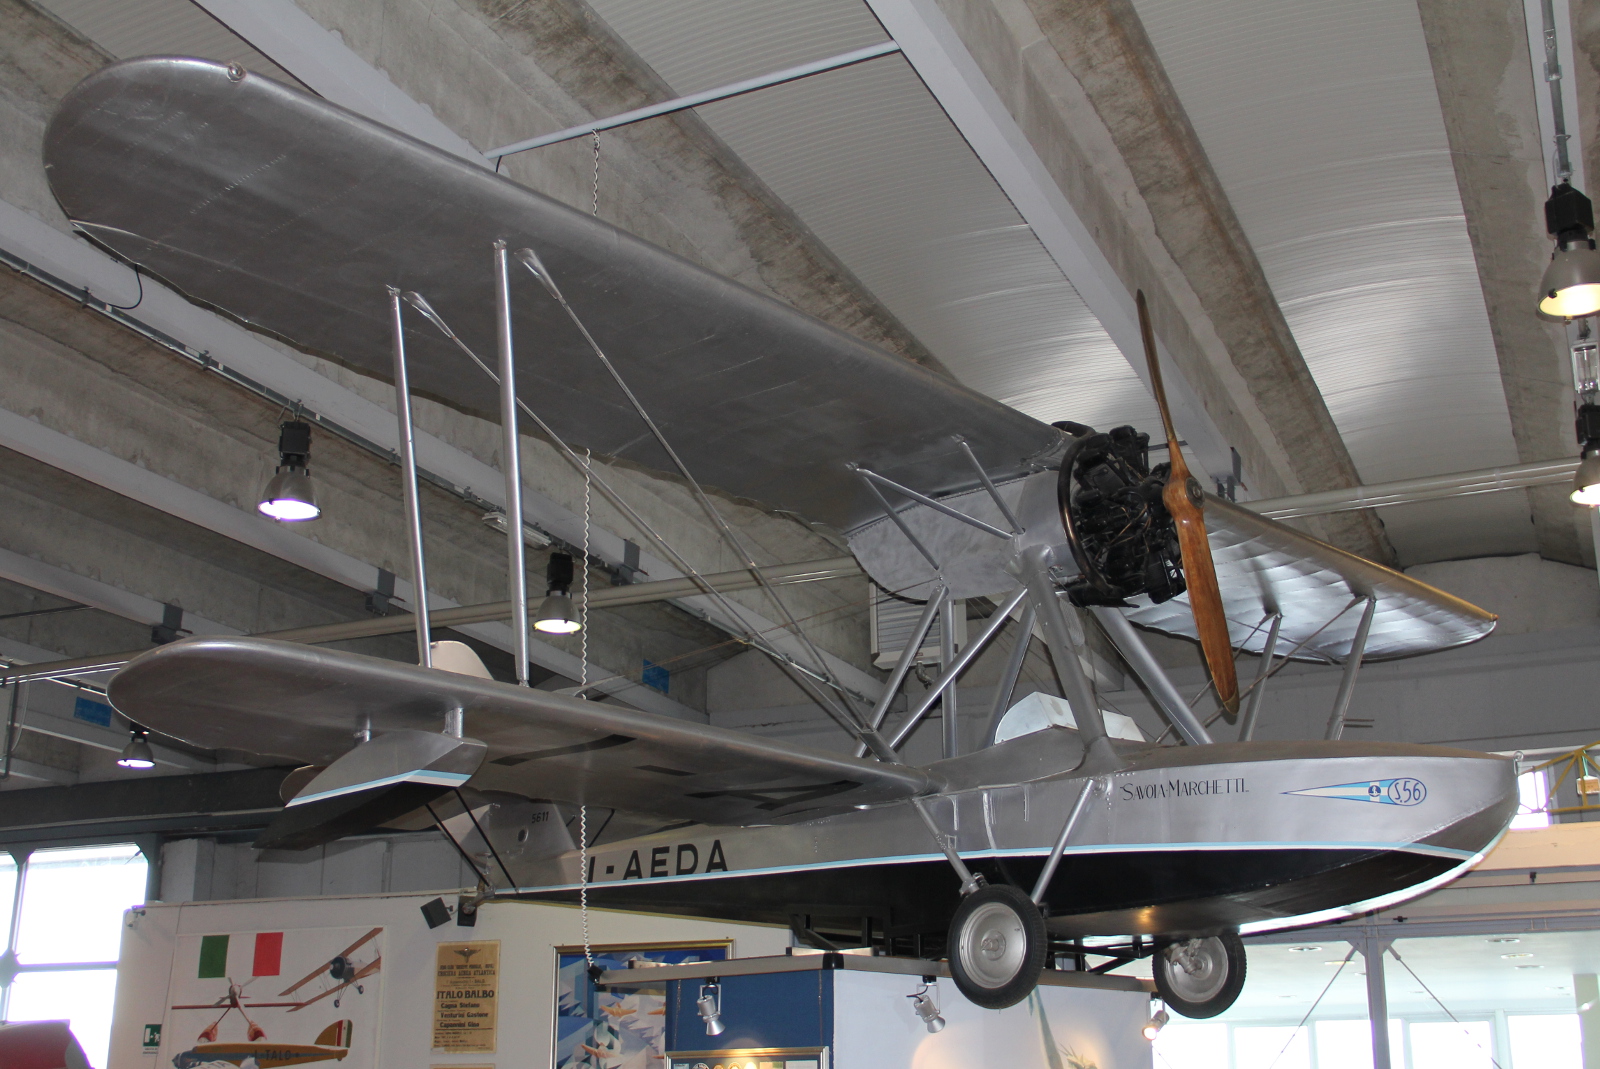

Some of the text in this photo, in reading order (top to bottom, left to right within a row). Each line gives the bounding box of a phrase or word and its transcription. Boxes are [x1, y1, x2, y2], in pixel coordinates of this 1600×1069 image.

[531, 811, 549, 824] 5611
[587, 839, 729, 883] I-AEDA
[437, 989, 494, 999] ITALO BALBO
